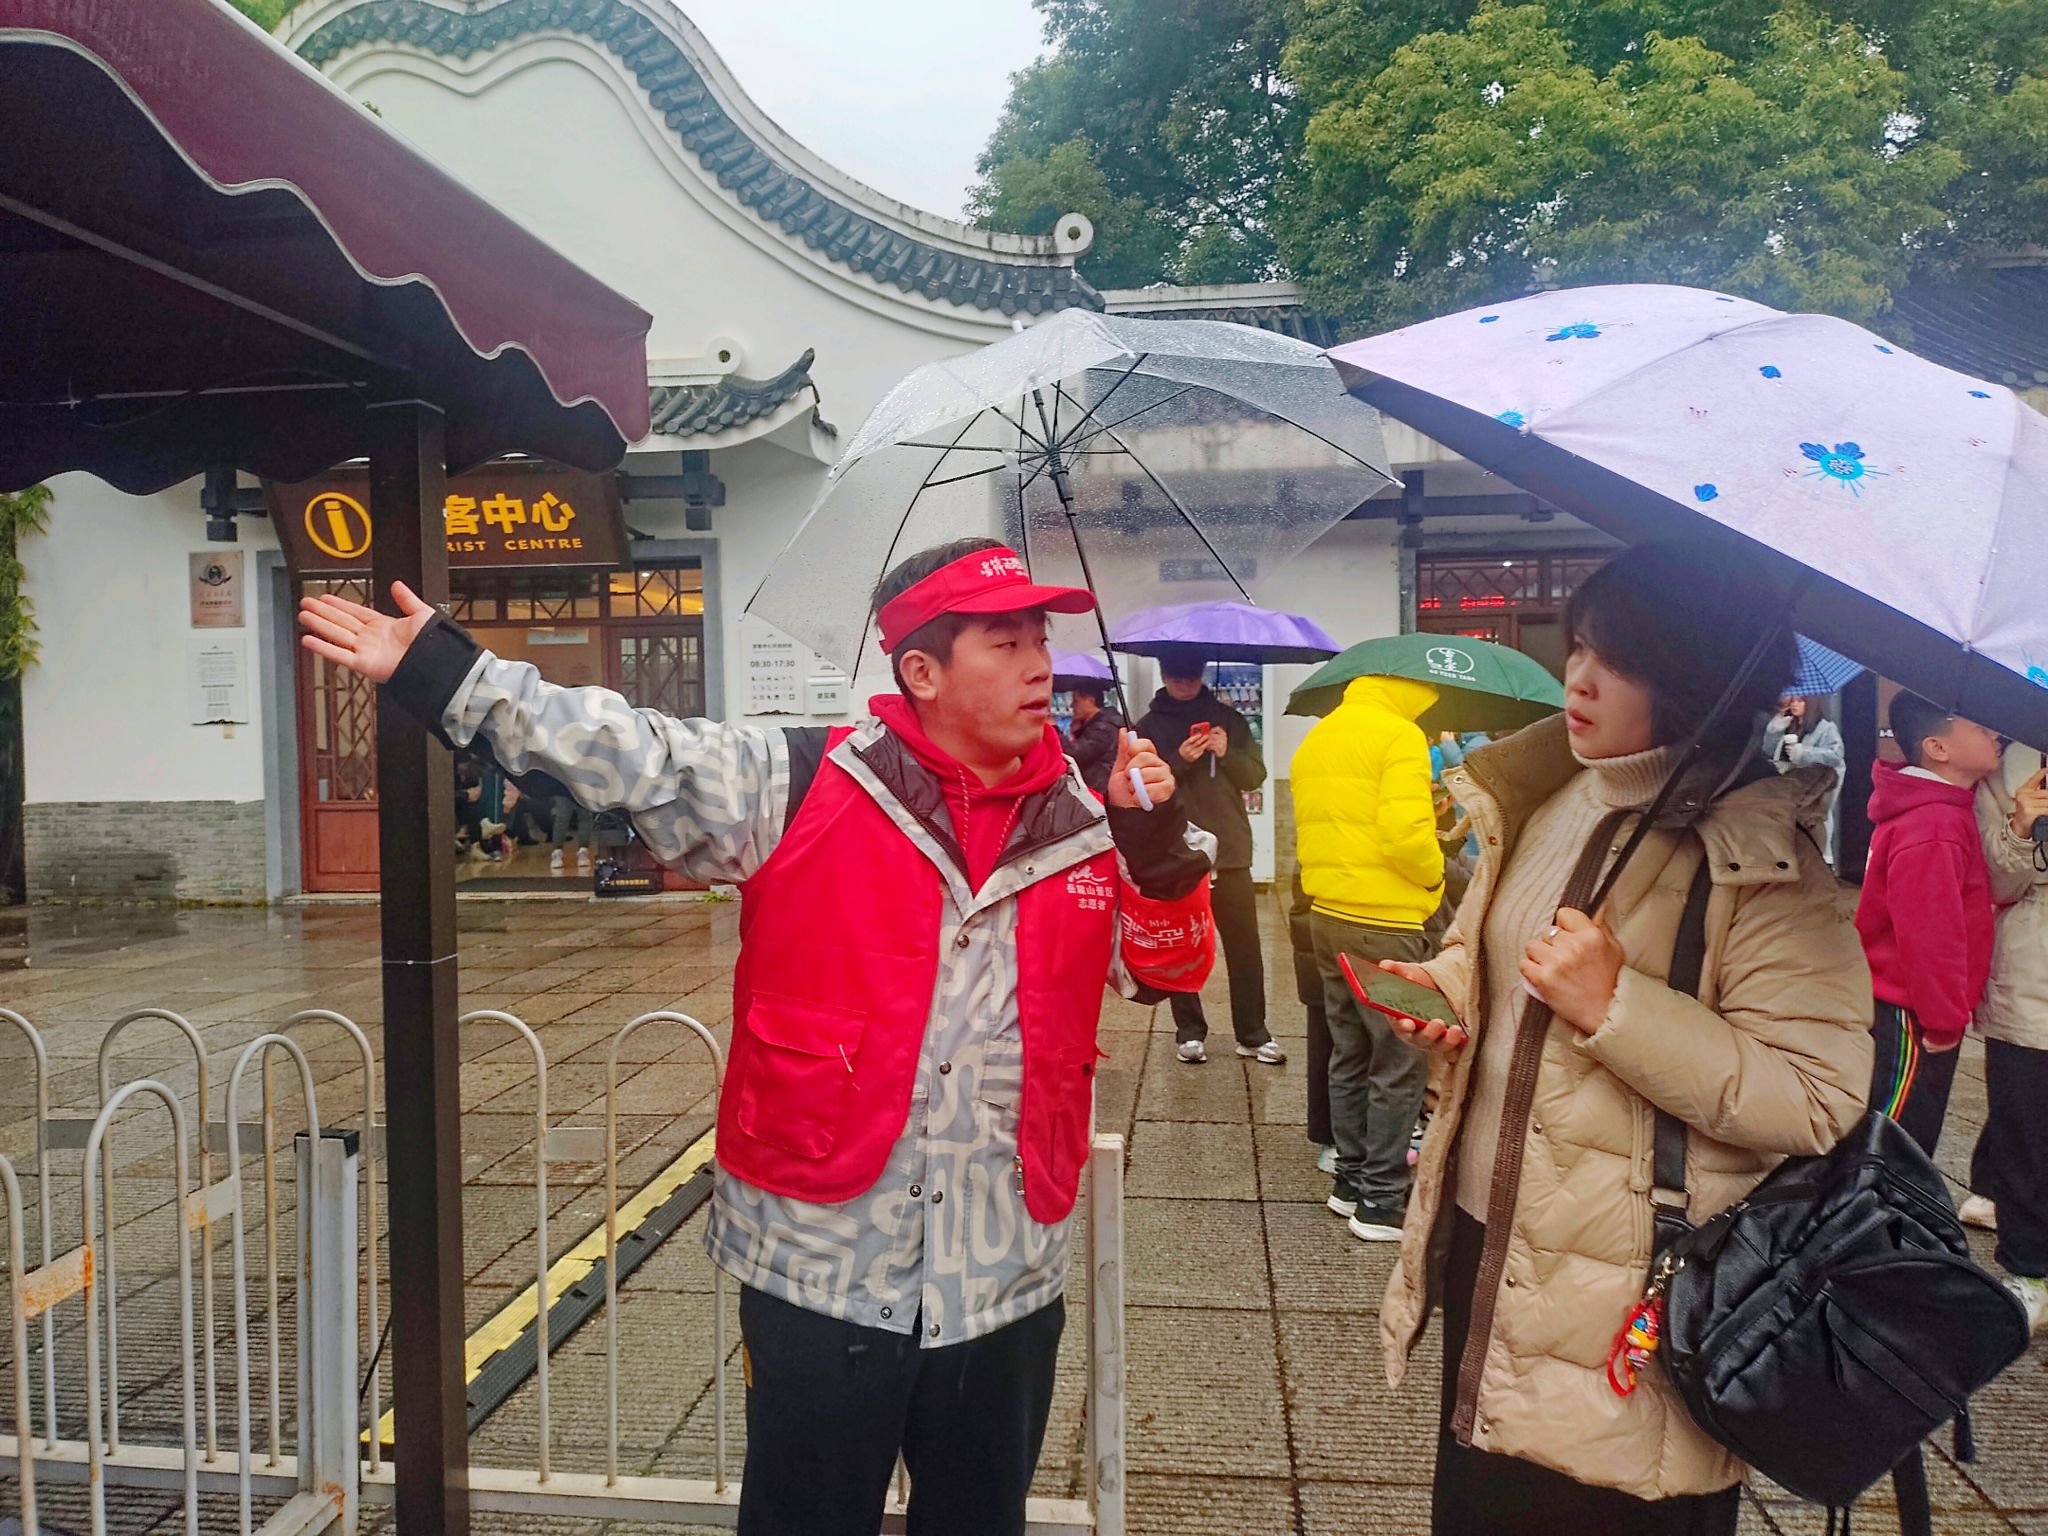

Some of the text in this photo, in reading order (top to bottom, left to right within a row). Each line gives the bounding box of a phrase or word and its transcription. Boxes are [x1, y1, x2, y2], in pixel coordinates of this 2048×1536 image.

[503, 537, 583, 551] CENTRE
[750, 660, 796, 668] 08:30-17:30
[1066, 883, 1115, 898] 岳麓山景区
[1078, 898, 1107, 911] 志愿者
